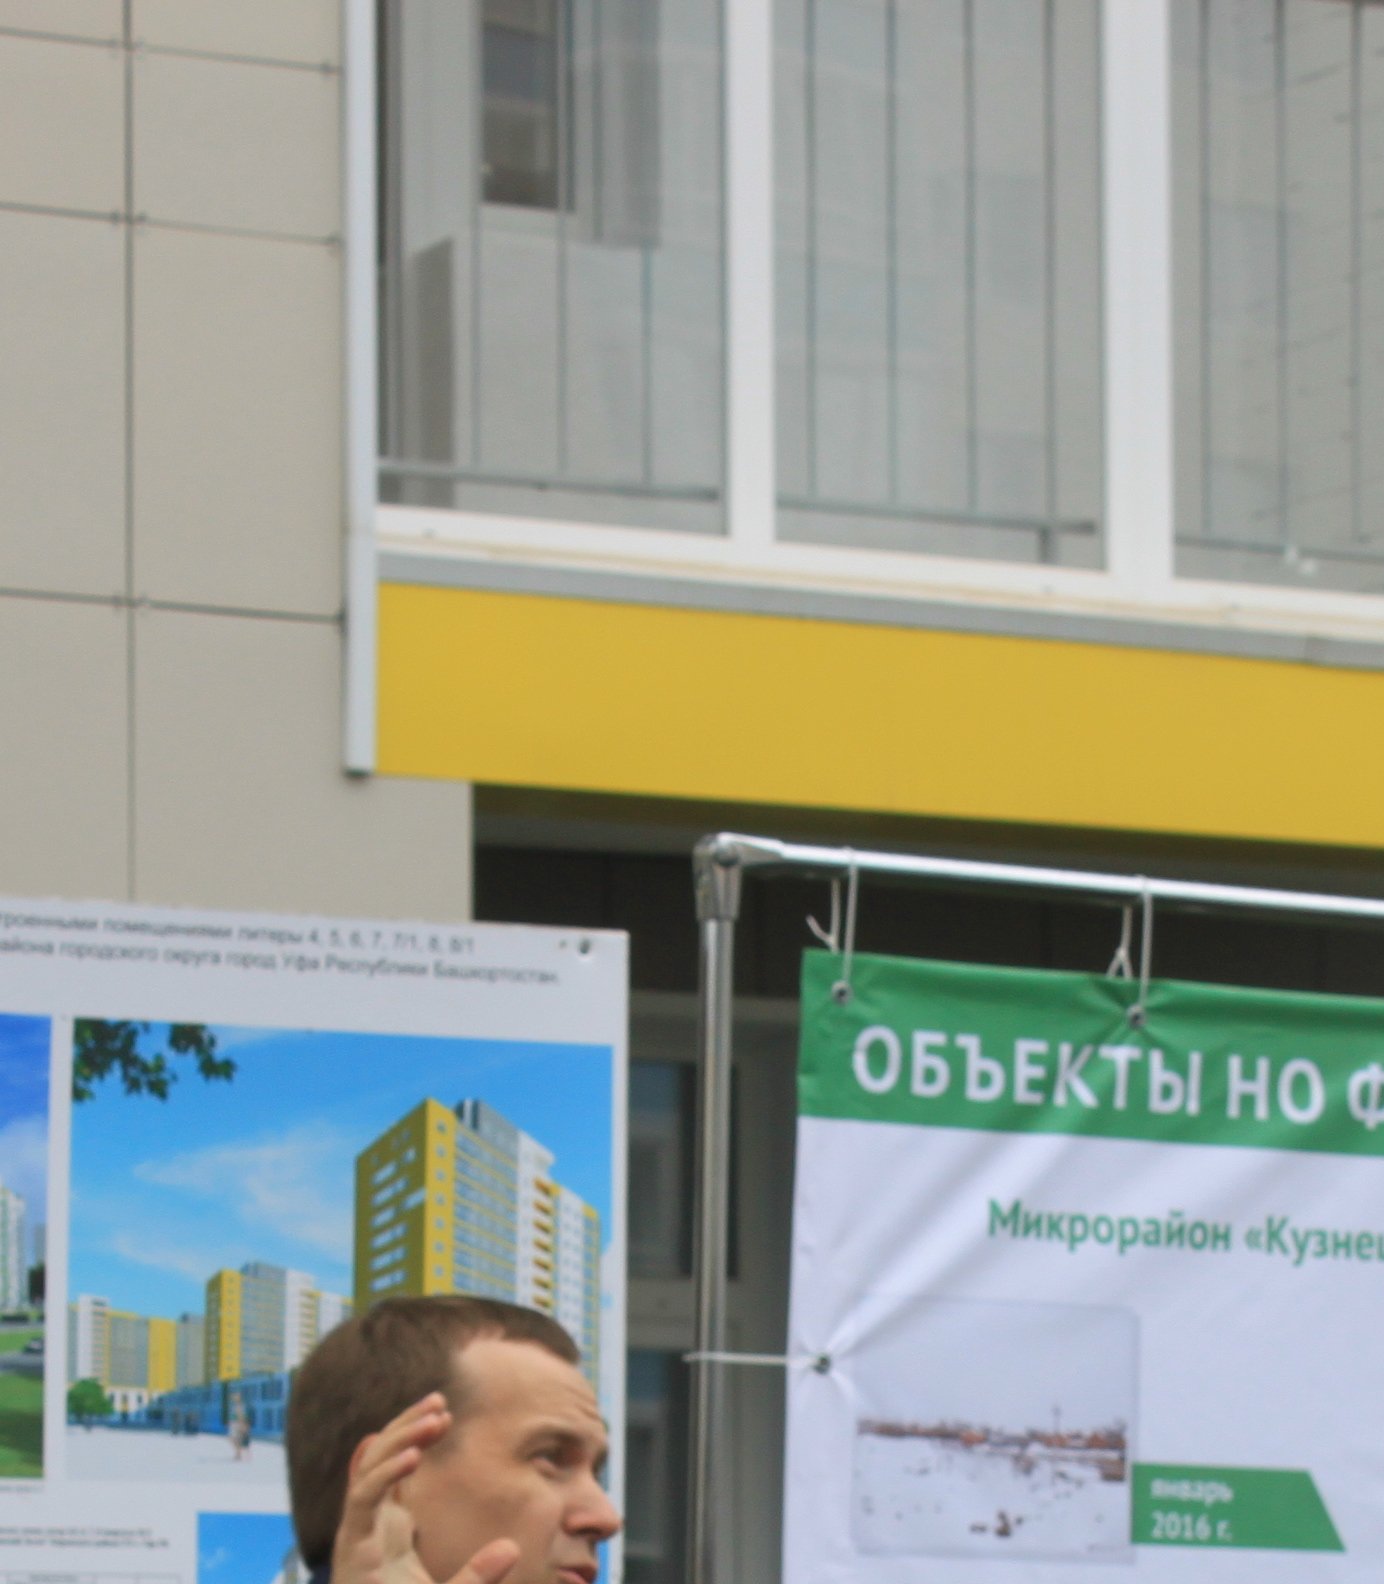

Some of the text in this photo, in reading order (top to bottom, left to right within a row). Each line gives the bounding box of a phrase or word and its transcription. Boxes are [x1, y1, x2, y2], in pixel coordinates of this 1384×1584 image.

[0, 911, 99, 931] роенными
[852, 1024, 1203, 1117] ОБЪЕКТЫ
[1226, 1053, 1326, 1125] НО
[988, 1199, 1232, 1256] Микрорайон
[1151, 1479, 1235, 1507] январь
[1151, 1511, 1233, 1541] 2016 г.
